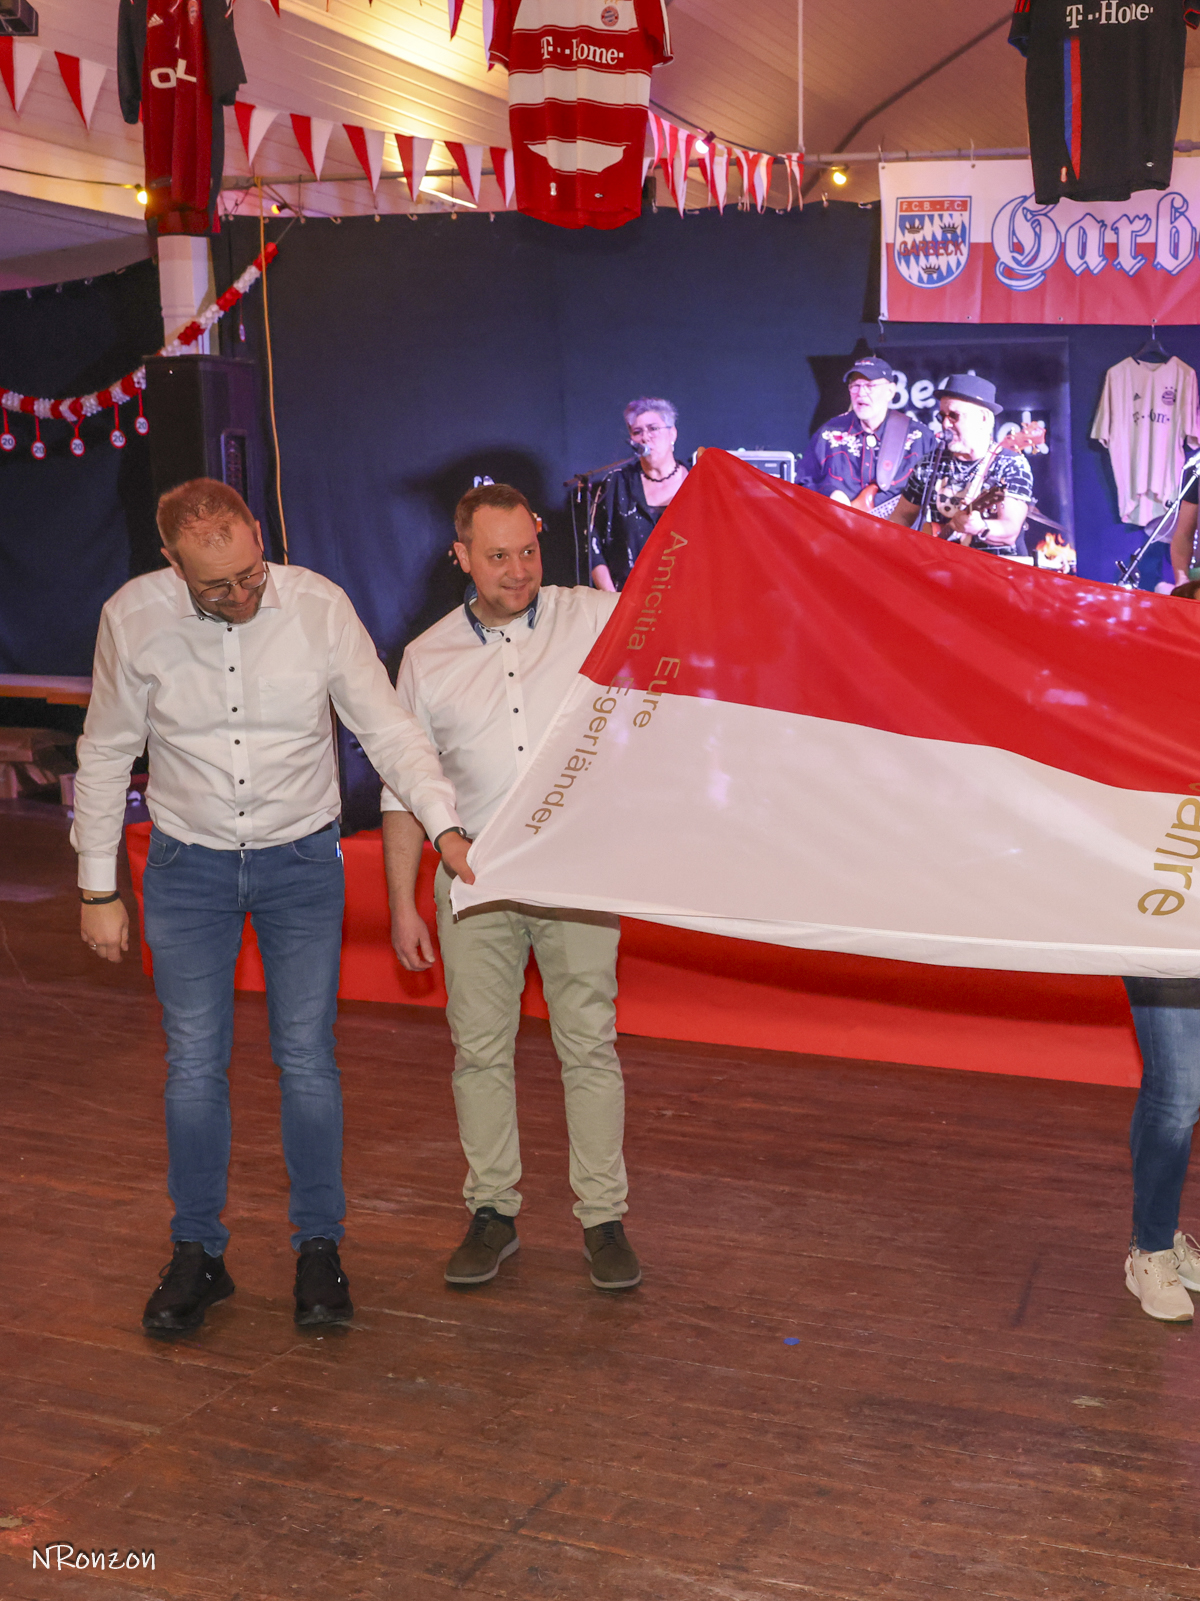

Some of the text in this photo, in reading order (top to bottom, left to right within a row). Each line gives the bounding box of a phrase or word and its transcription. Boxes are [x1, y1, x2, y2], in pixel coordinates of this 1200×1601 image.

[899, 240, 963, 256] GARBECK
[137, 421, 147, 430] 20
[3, 437, 14, 446] 20
[113, 434, 124, 443] 20
[34, 445, 45, 454] 20
[73, 442, 83, 451] 20
[525, 530, 688, 835] Amicitia Egerländer
[633, 656, 681, 728] Eure
